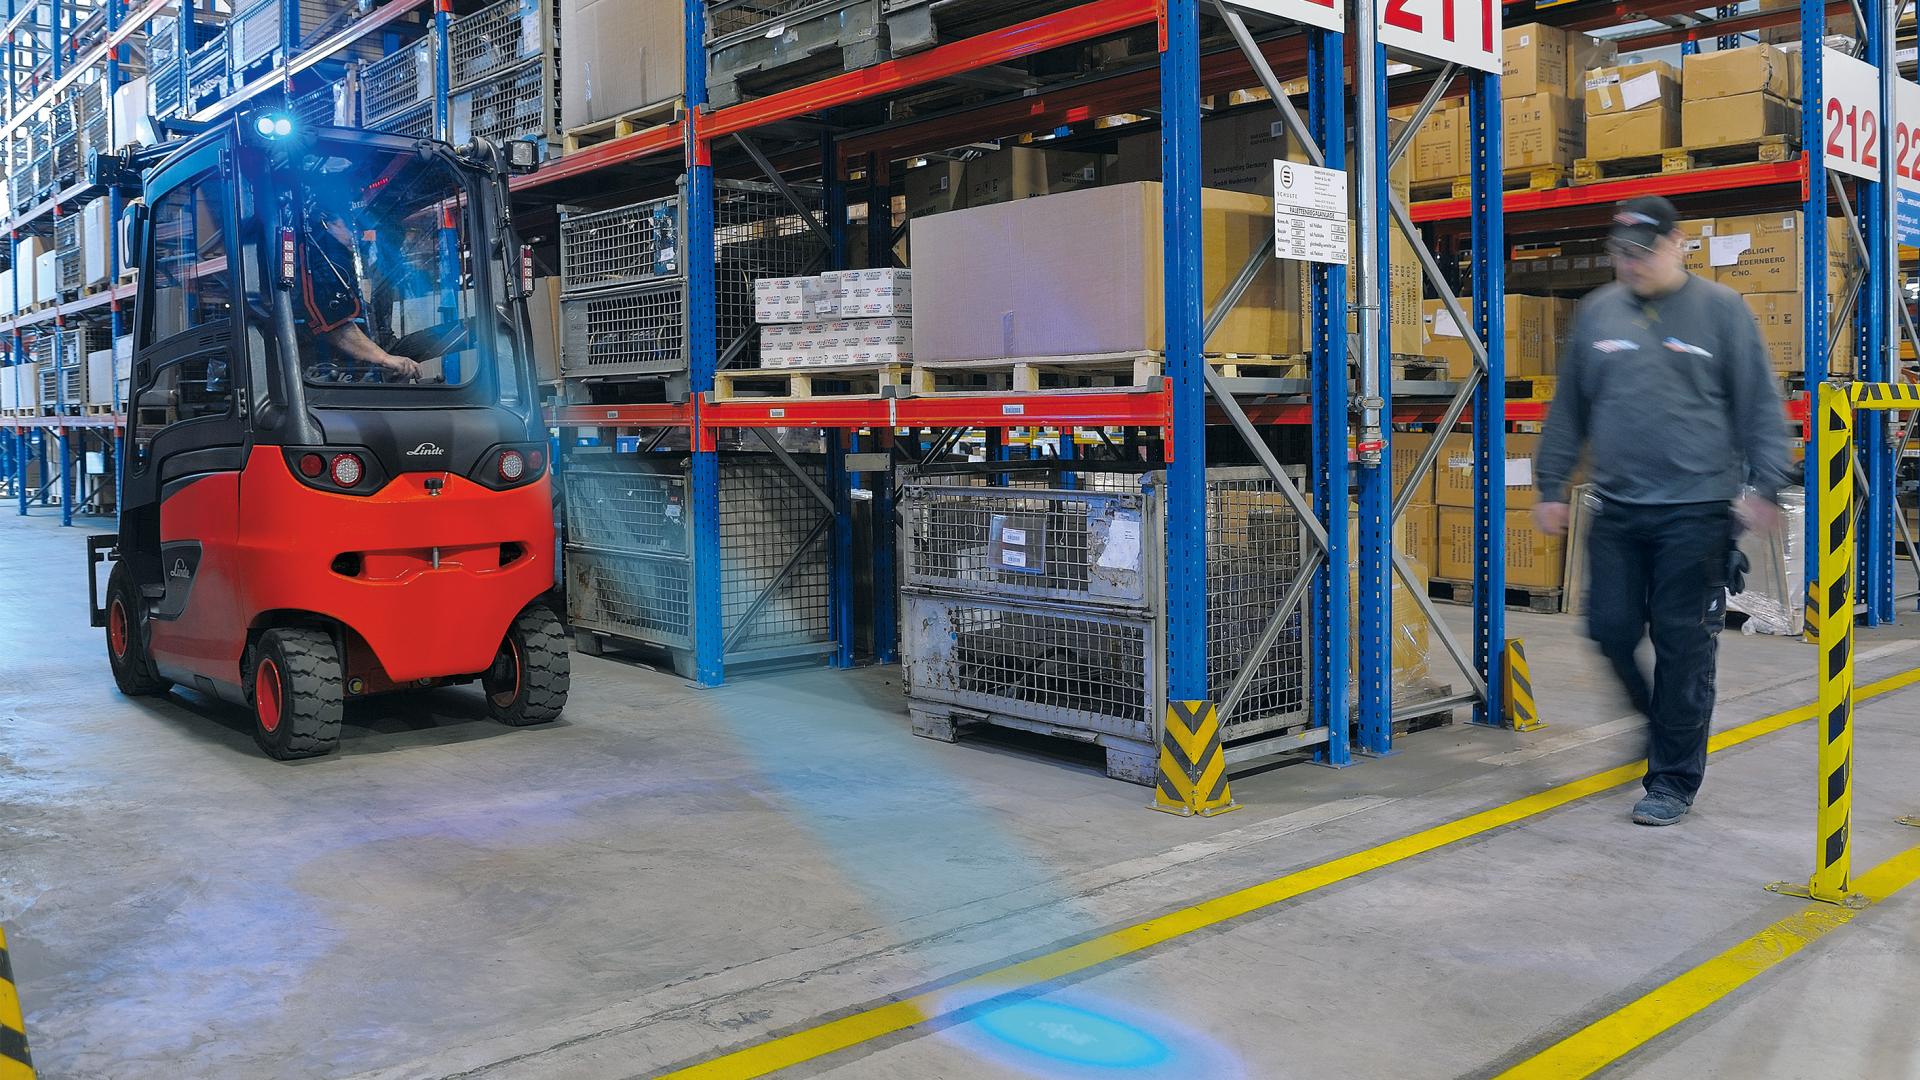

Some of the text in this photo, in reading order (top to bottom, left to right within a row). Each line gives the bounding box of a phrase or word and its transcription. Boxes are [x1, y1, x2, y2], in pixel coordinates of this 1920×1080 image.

[1826, 97, 1877, 168] 212
[406, 442, 445, 456] Linde
[170, 558, 190, 579] Linde
